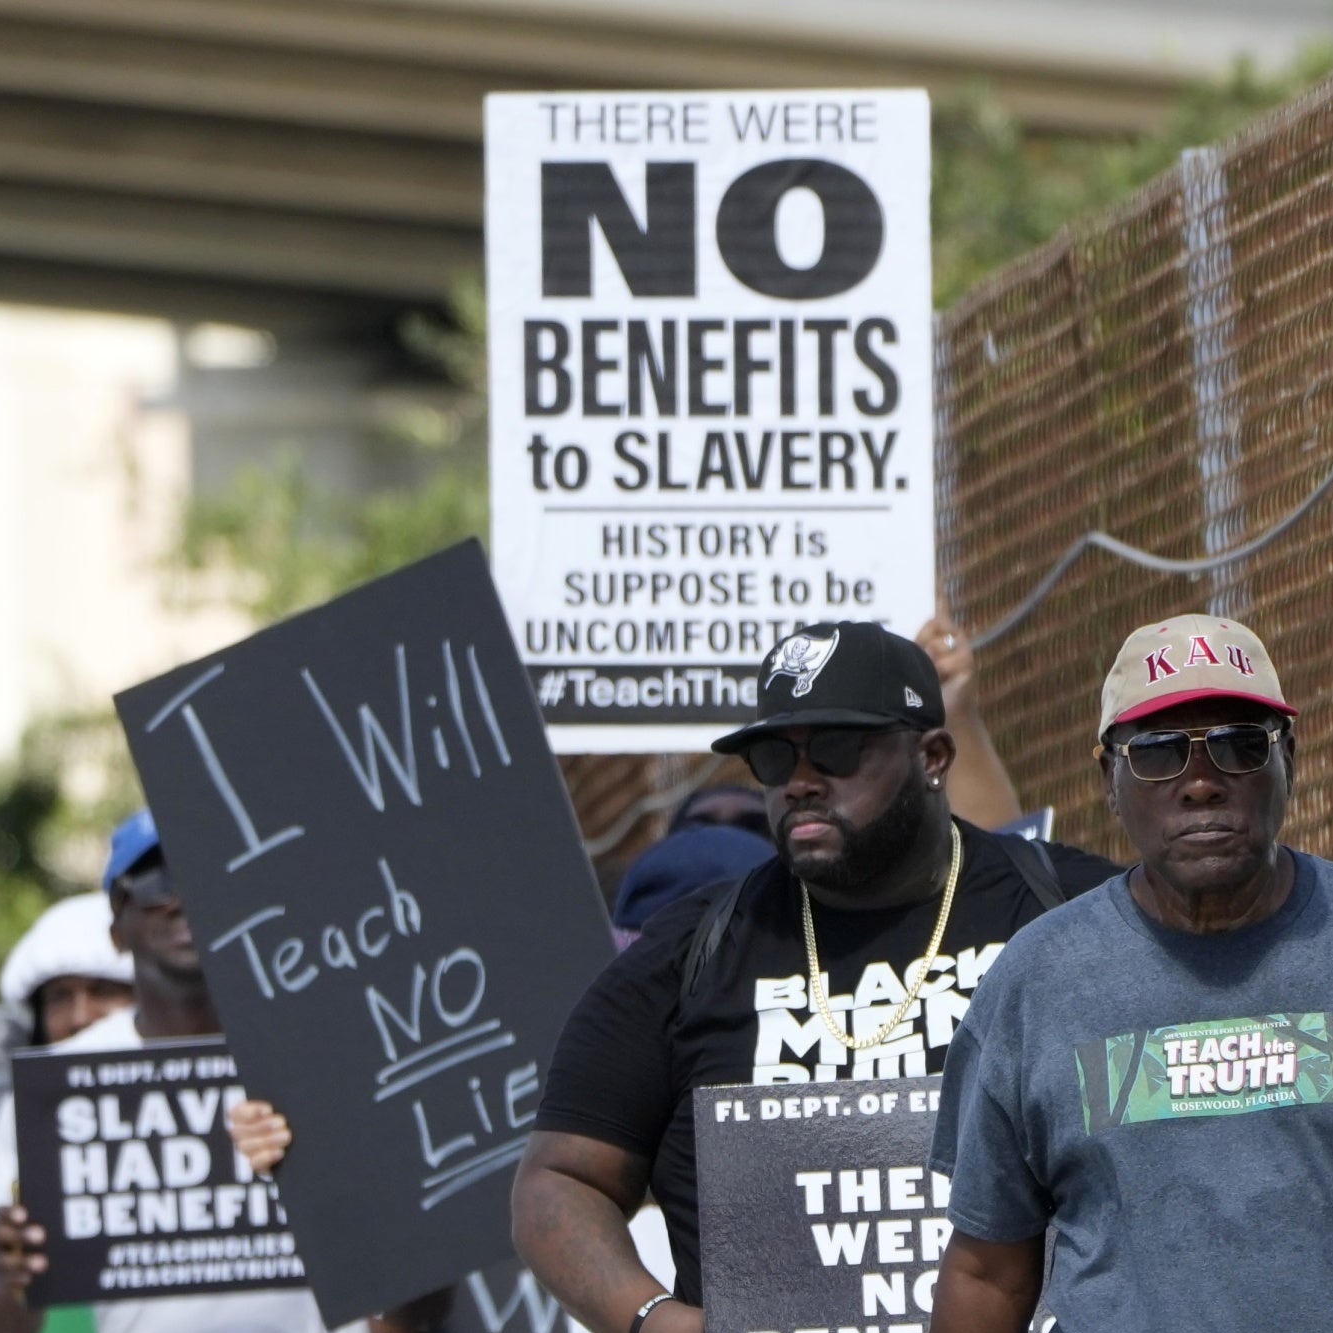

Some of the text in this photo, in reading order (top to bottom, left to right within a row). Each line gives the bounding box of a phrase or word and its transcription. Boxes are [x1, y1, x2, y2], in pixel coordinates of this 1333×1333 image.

[540, 102, 879, 143] THERE WERE
[540, 158, 886, 300] NO
[522, 317, 902, 419] BENEFITS
[528, 430, 909, 491] to SLAVERY.
[601, 523, 829, 558] HISTORY is
[564, 571, 876, 606] SUPPOSE to be
[525, 619, 890, 655] UNCOMFORT
[146, 639, 512, 873] I Will
[208, 856, 422, 999] Teach
[365, 946, 487, 1064] NO
[1163, 1032, 1296, 1066] TEACH the
[1189, 1028, 1219, 1038] CENTER
[1219, 1027, 1234, 1035] FOR
[1234, 1023, 1261, 1033] RACIAL
[1261, 1019, 1292, 1032] JUSTICE
[1166, 1053, 1298, 1097] TRUTH
[715, 1100, 751, 1123] FL
[760, 1095, 852, 1121] DEPT.
[858, 1091, 899, 1115] OF
[1171, 1090, 1297, 1112] ROSEWOOD, FLORIDA
[60, 1135, 212, 1195] HAD
